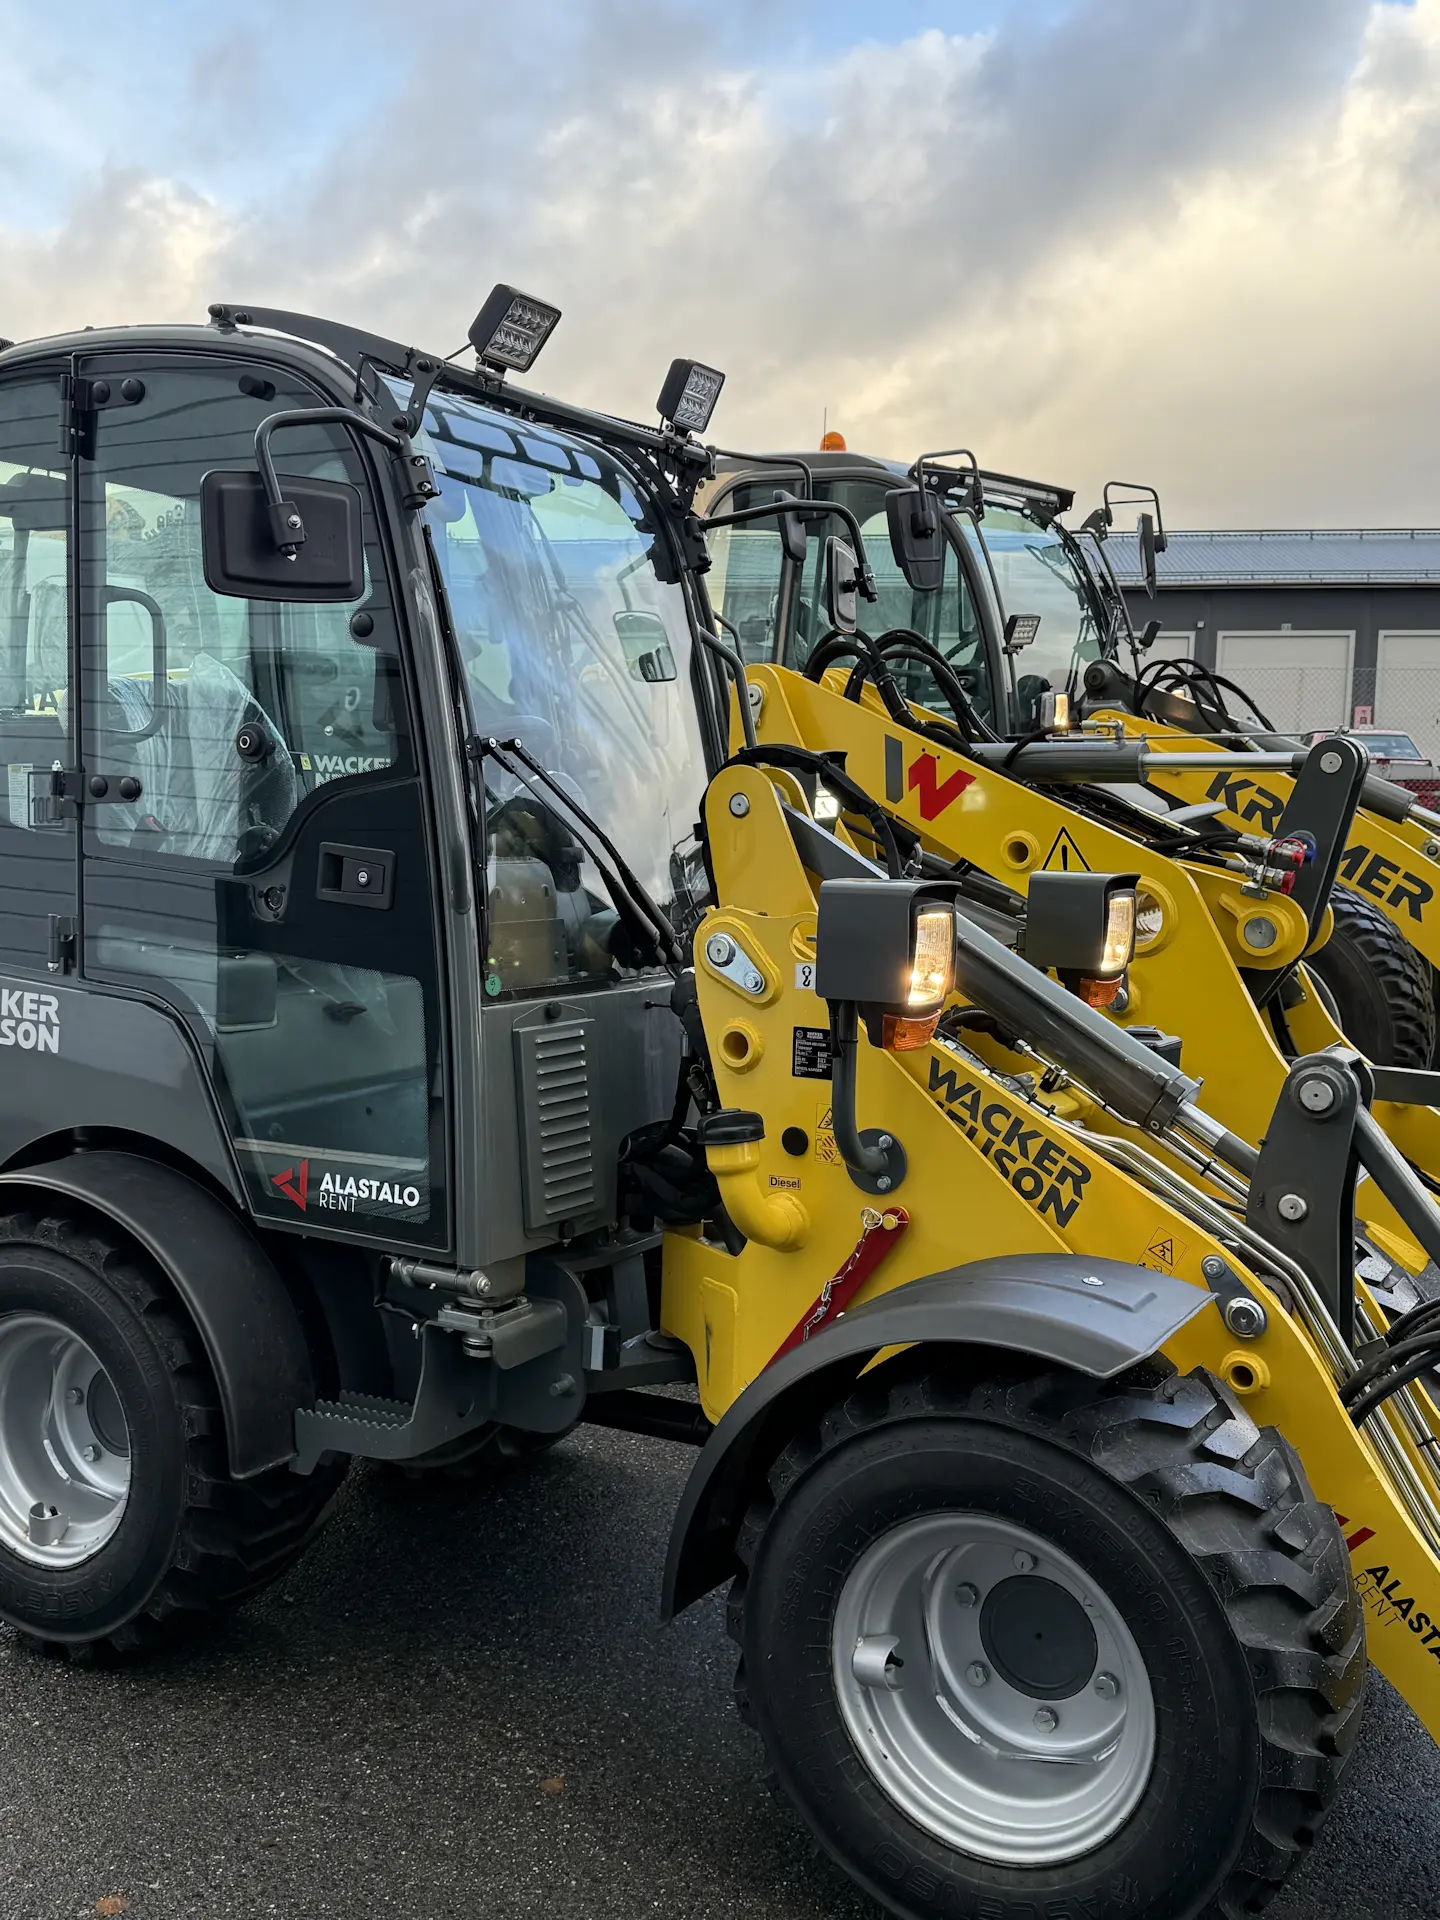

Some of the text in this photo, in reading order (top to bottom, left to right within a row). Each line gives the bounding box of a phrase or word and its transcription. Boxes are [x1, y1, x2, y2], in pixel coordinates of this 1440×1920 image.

[928, 1055, 1092, 1201] WACKER
[319, 1172, 420, 1207] ALASTALO
[770, 1176, 800, 1189] Diesel
[319, 1191, 357, 1213] RENT
[1353, 1571, 1402, 1628] RENT
